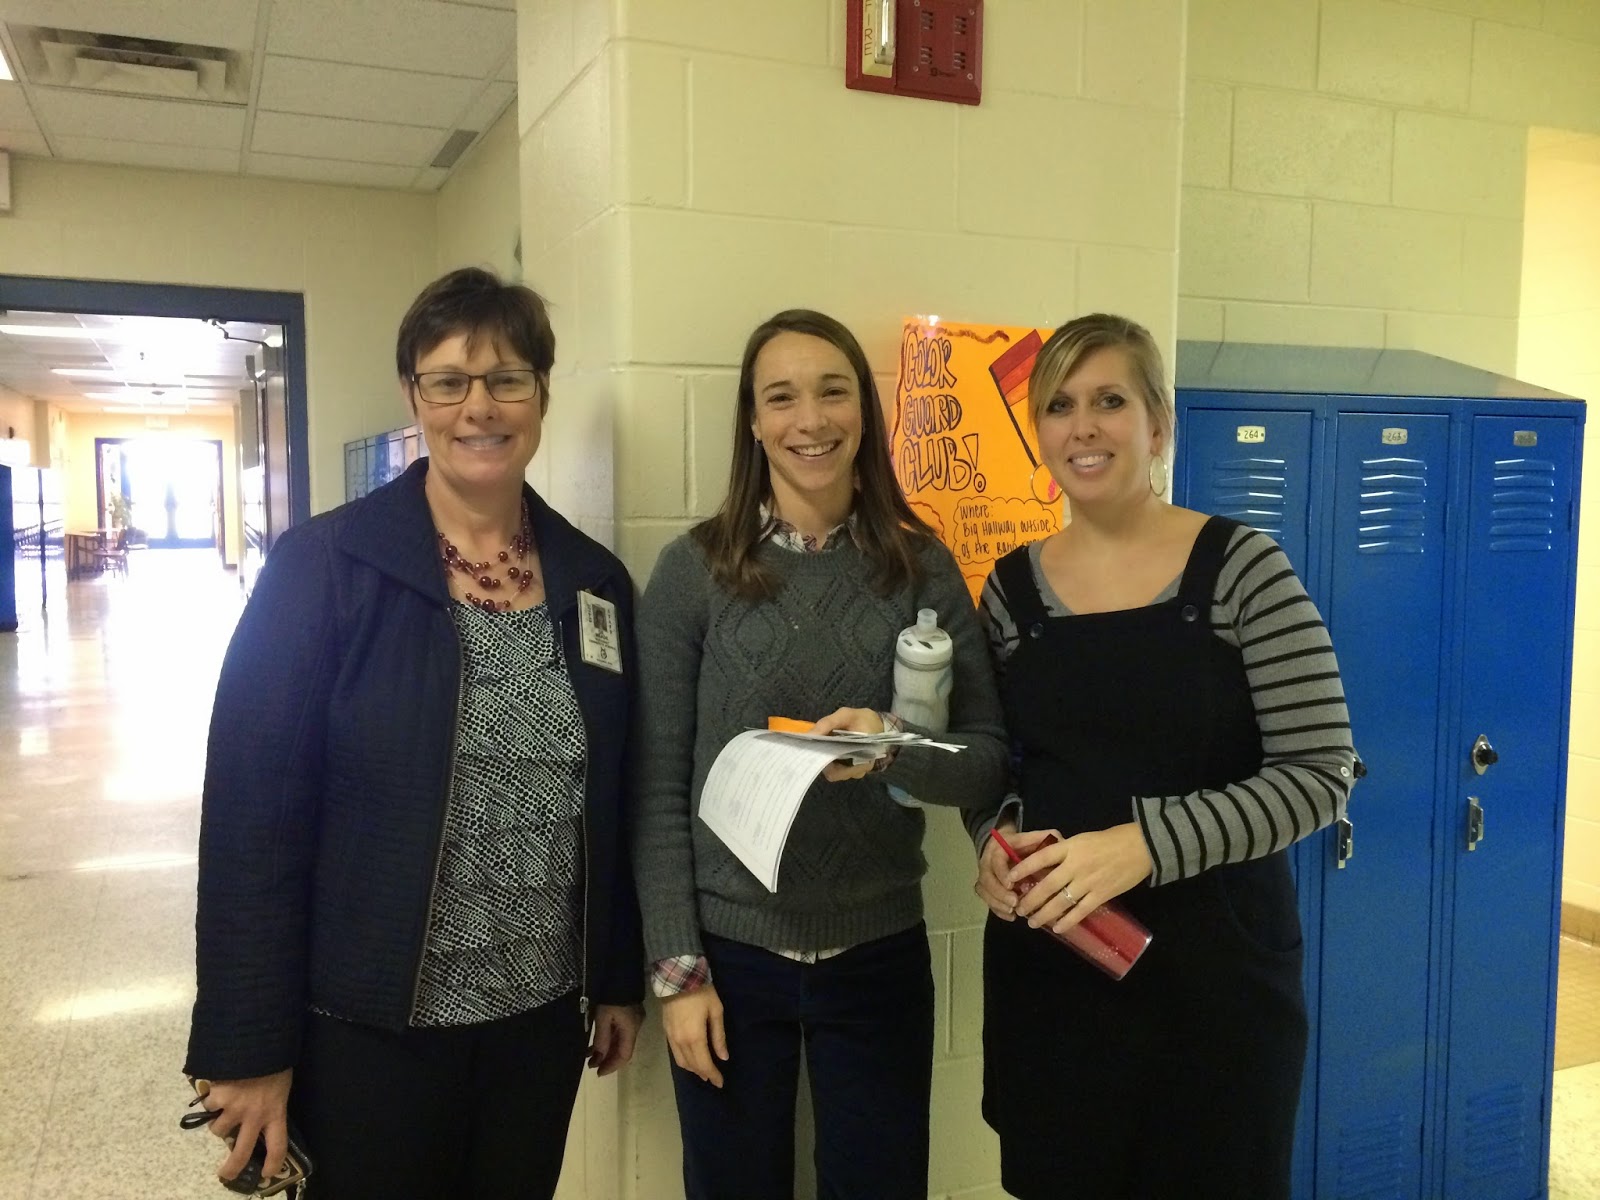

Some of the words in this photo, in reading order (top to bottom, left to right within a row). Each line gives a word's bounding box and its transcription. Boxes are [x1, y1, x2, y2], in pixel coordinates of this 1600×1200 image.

[903, 331, 958, 392] COLOR
[902, 394, 962, 439] GUARD
[1243, 430, 1259, 440] 264
[899, 433, 987, 496] CLUB!
[962, 521, 980, 544] Big
